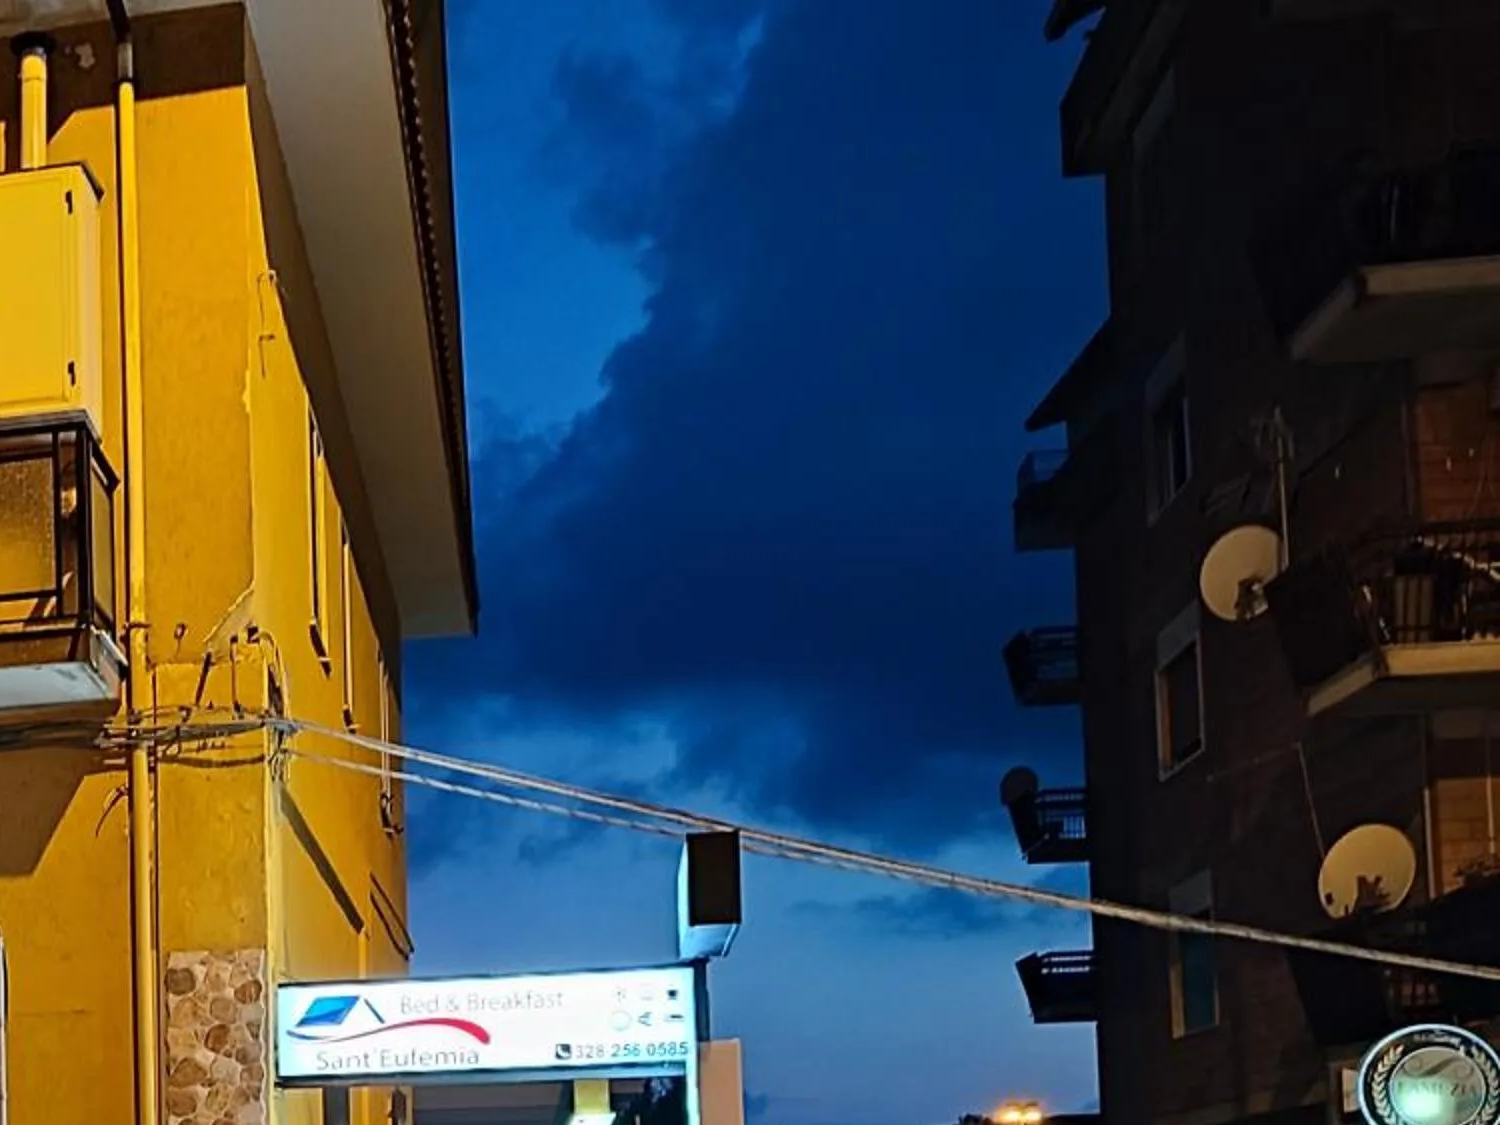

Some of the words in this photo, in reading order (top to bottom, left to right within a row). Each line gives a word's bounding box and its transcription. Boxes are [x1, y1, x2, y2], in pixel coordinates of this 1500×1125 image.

[401, 994, 439, 1015] Bed
[467, 990, 563, 1012] Breakfast
[575, 1044, 605, 1059] 328
[611, 1043, 641, 1057] 256
[646, 1041, 689, 1056] 0585
